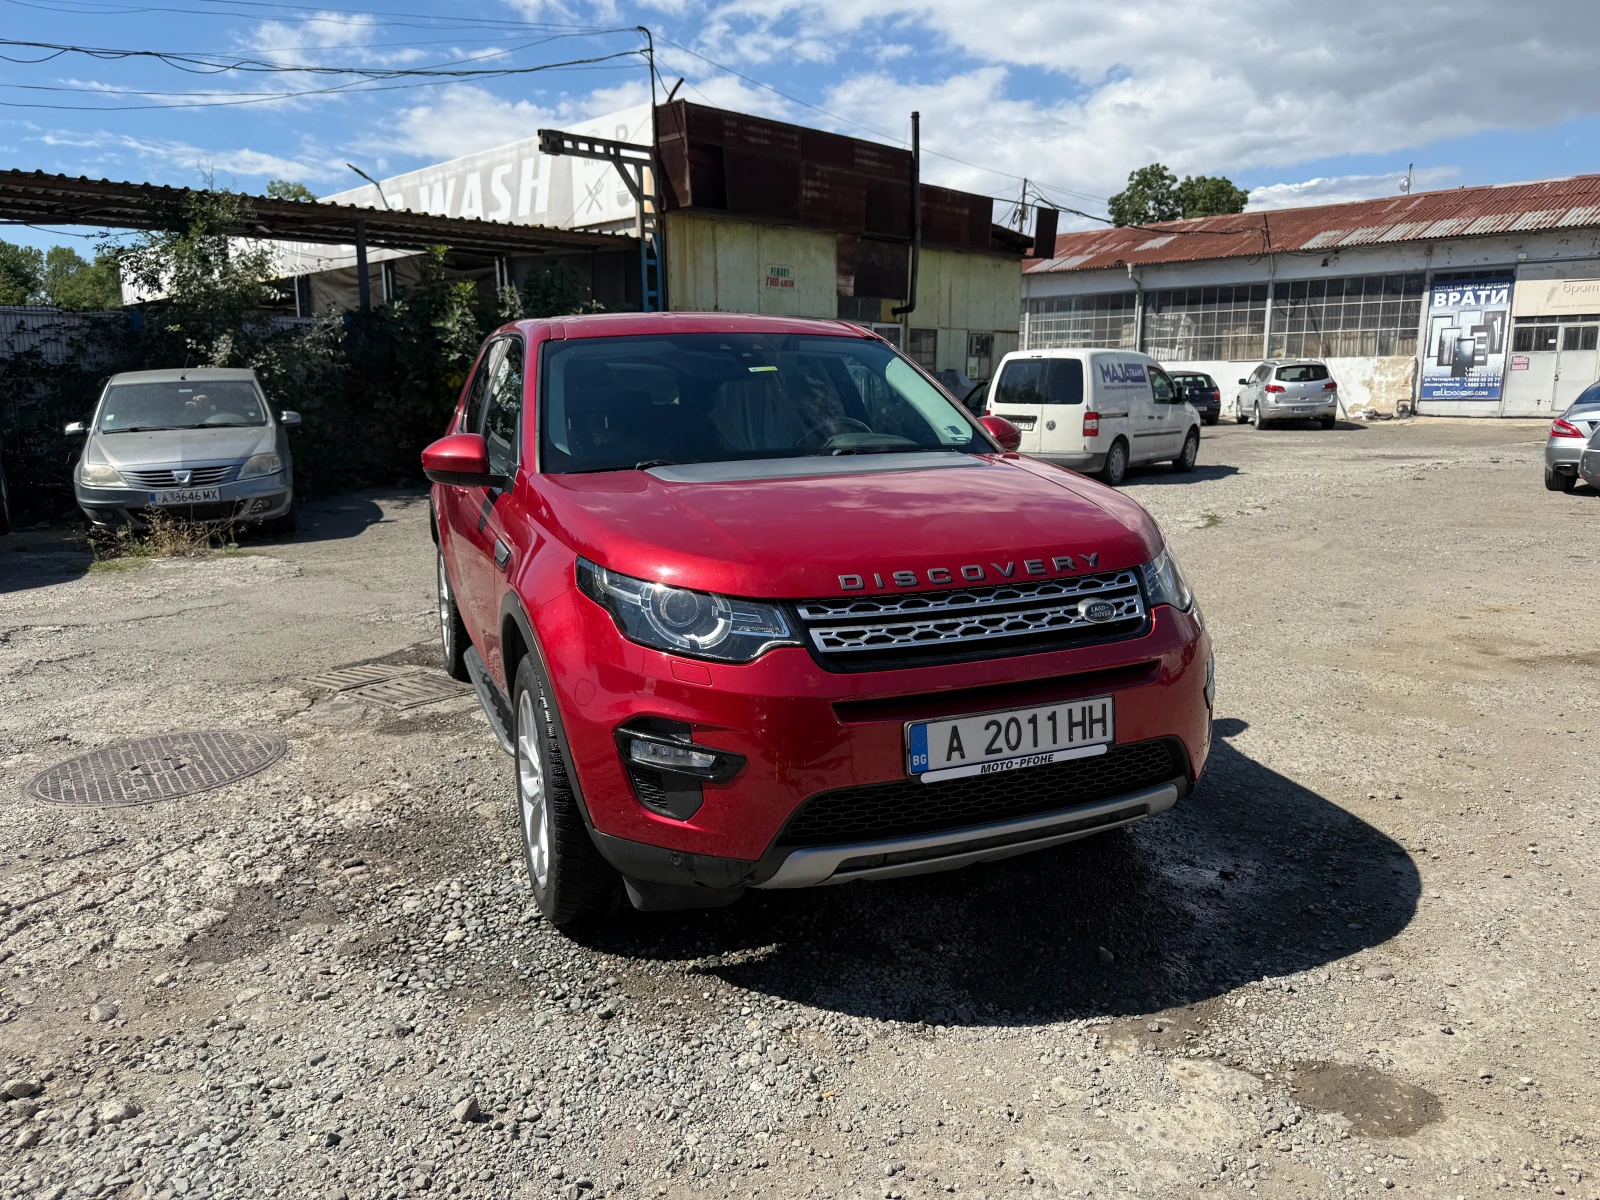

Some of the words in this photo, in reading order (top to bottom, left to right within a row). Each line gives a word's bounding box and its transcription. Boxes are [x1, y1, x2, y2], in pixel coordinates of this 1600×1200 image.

[418, 154, 552, 221] WASH
[1433, 289, 1509, 308] ВРАТИ
[1099, 362, 1132, 384] MAJA
[837, 552, 1100, 591] DISCOVERY
[946, 725, 966, 762] A
[984, 710, 1058, 756] 2011
[1068, 703, 1107, 742] HH
[912, 754, 927, 767] BG
[980, 753, 1055, 774] MOTO-PFOHE
